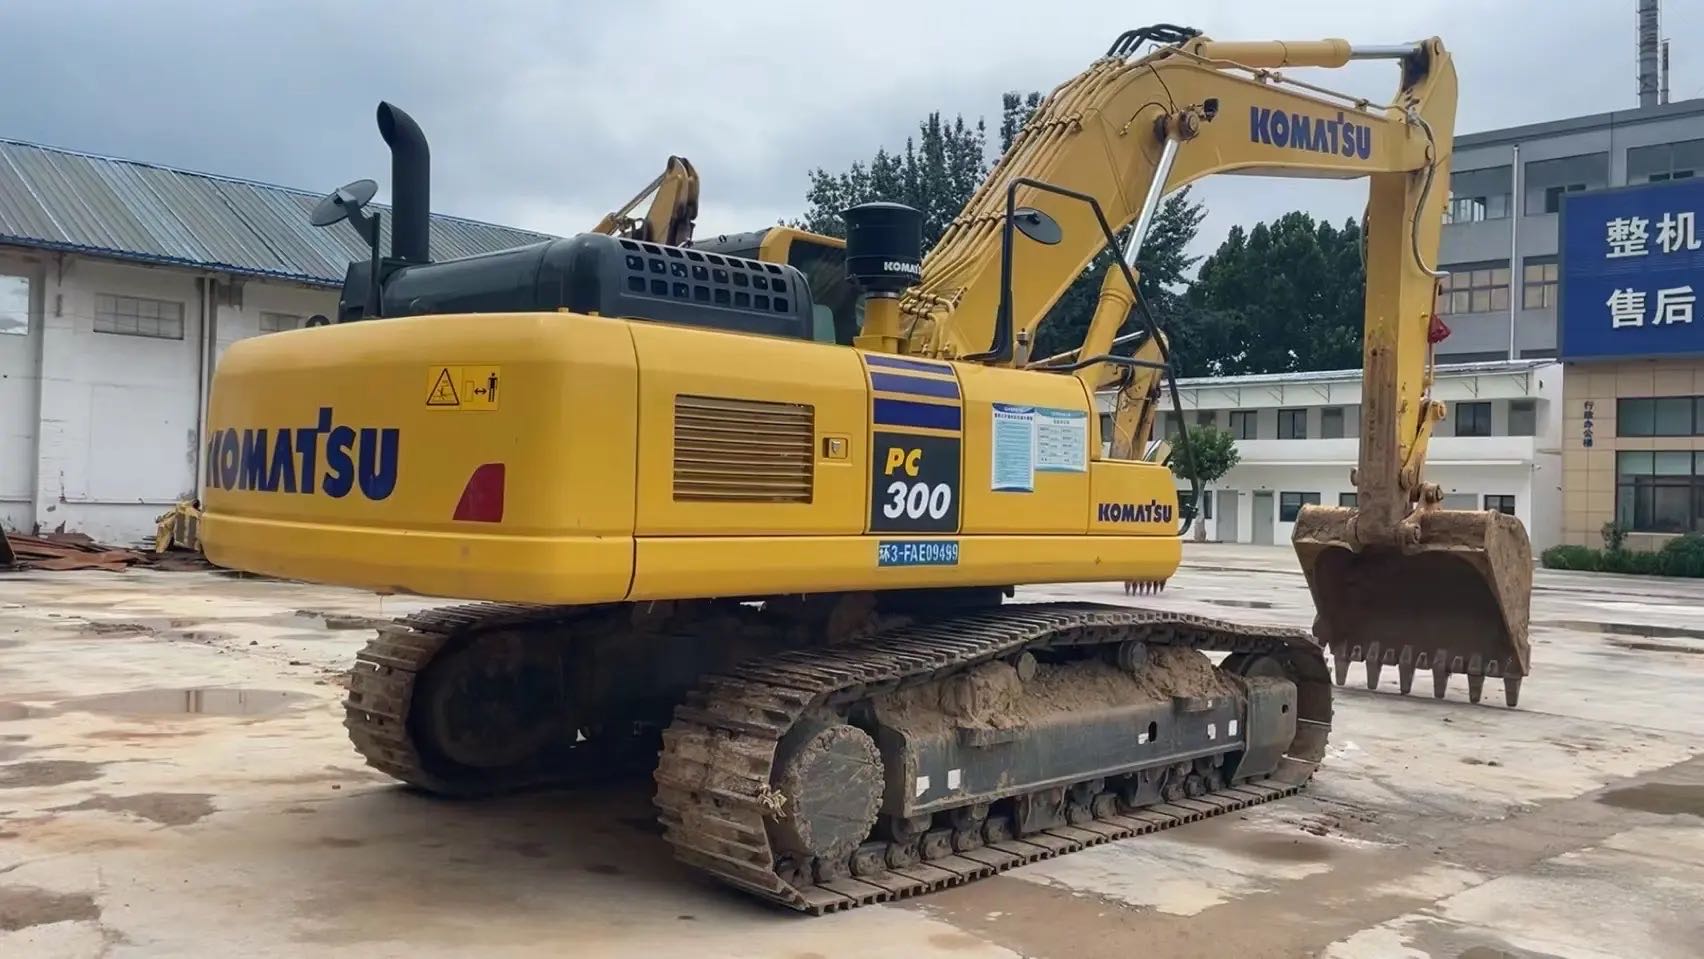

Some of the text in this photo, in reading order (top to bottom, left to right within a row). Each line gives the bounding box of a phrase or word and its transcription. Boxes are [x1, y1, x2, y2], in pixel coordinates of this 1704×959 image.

[1250, 106, 1371, 160] KOMATSU
[1606, 211, 1701, 259] 整机
[1606, 286, 1696, 328] 售后
[206, 407, 400, 500] KOMATSU
[884, 448, 922, 476] PC
[883, 481, 951, 519] 300
[1098, 499, 1173, 523] KOMATSU
